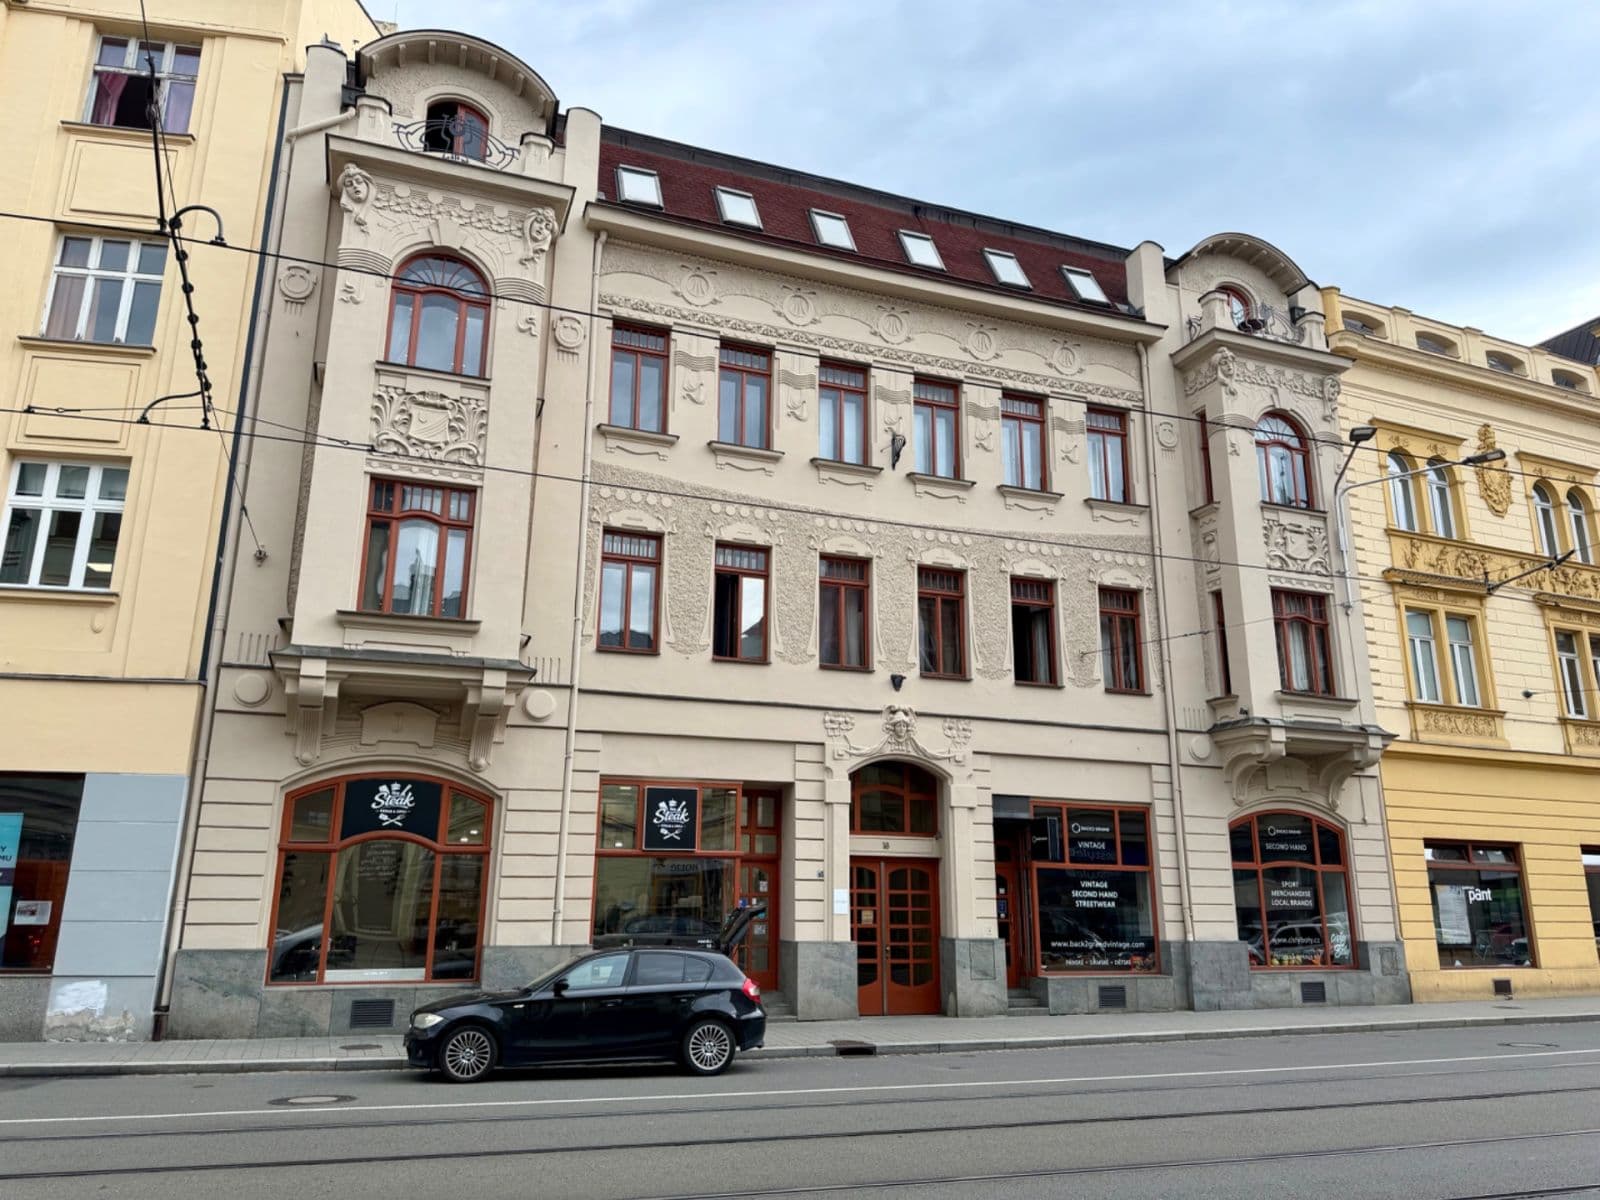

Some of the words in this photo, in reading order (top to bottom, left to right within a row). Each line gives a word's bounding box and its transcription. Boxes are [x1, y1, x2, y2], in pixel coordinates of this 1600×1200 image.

[371, 791, 416, 809] Steak
[653, 808, 690, 824] Steak
[1077, 840, 1106, 850] VINTAGE
[1265, 842, 1289, 851] SECOND
[1290, 843, 1308, 852] HAND
[1080, 880, 1108, 889] VINTAGE
[1281, 880, 1300, 888] SPORT
[1071, 889, 1098, 898] SECOND
[1098, 890, 1118, 899] HAND
[1271, 889, 1312, 898] MERCHANDISE
[1075, 900, 1116, 908] STREETWEAR
[1271, 899, 1290, 907] LOCAL
[1291, 899, 1313, 907] BRANDS
